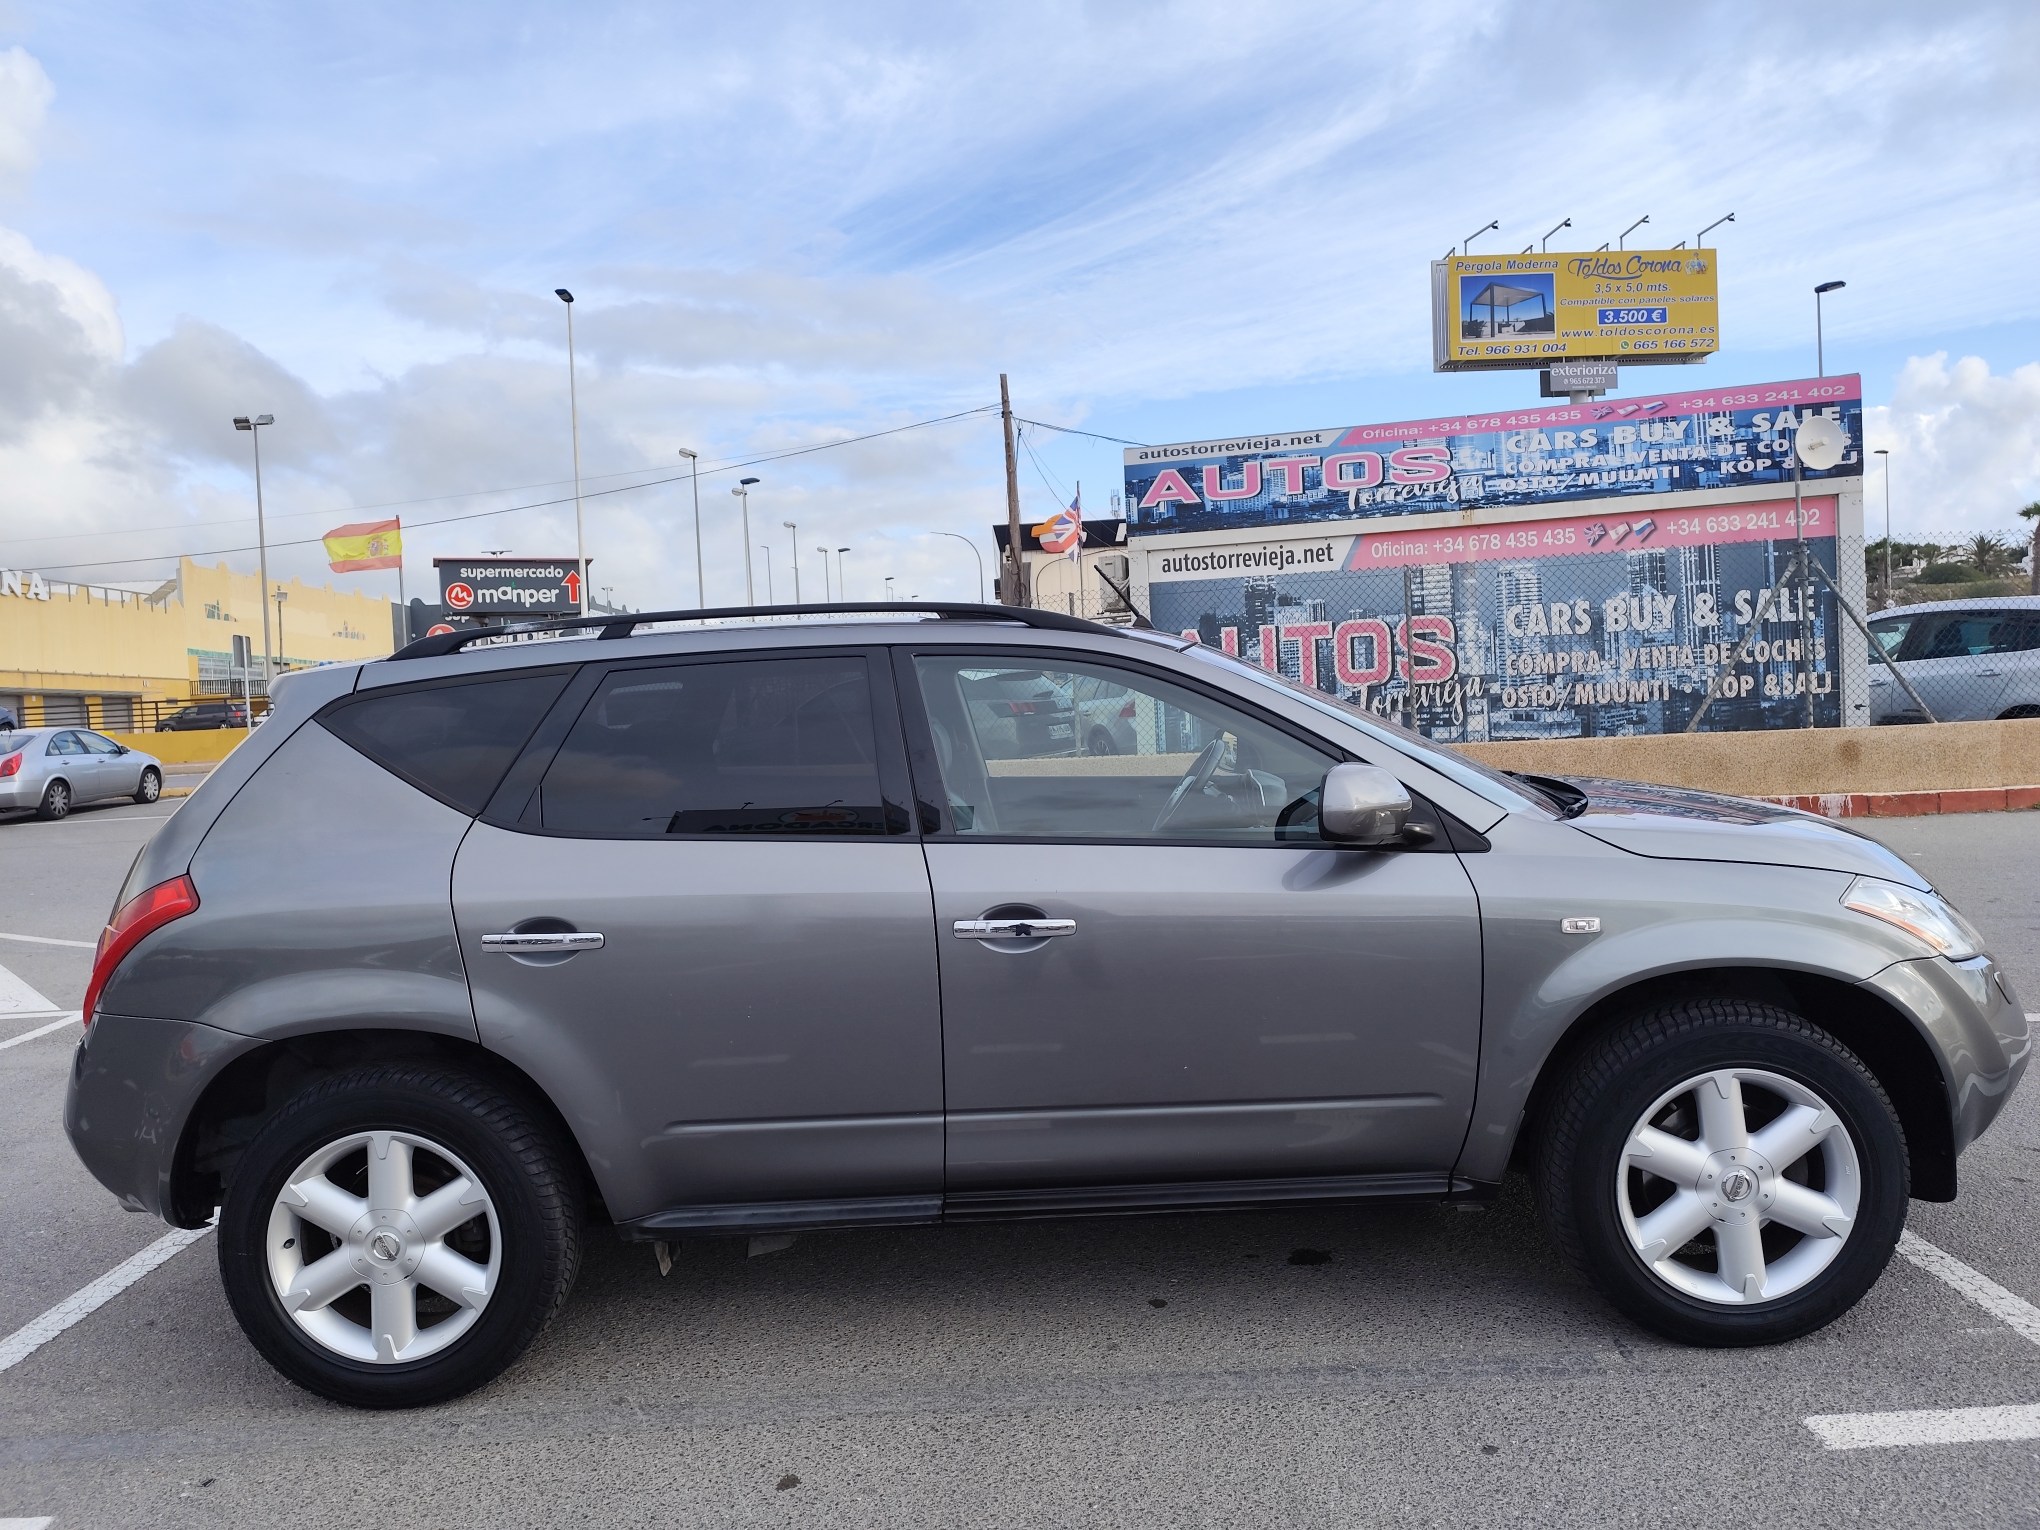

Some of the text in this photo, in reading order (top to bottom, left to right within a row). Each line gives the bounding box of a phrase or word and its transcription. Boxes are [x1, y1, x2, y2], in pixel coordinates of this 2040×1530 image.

[1506, 258, 1559, 270] Moderna
[1567, 255, 1682, 279] Toldos Corona
[1594, 282, 1612, 293] 3,5
[1625, 282, 1643, 293] 5,0
[1646, 282, 1671, 292] mts.
[1559, 294, 1714, 307] Compatible con paneles solares
[1604, 309, 1662, 323] 3.500 €
[1561, 325, 1715, 338] www.toldoscorona.es
[1457, 342, 1567, 356] Tel. 966 931 004
[1633, 338, 1715, 350] 665 166 572
[1551, 364, 1617, 376] exterioriza
[1569, 377, 1581, 385] 965
[1679, 385, 1846, 410] +34 633 241 402
[1138, 410, 1581, 461] autostorrevieja.net Oficina: +34 678 435 435
[1506, 428, 1598, 453] CARS
[1613, 420, 1691, 445] BUY
[1707, 416, 1735, 437] &
[1505, 453, 1608, 475] COMPRA
[1718, 441, 1748, 457] DE
[1720, 457, 1773, 475] KÖP
[1138, 446, 1453, 508] AUTOS
[1342, 475, 1485, 511] Torrevieja
[1666, 508, 1820, 536] +34 633 241 402
[1161, 527, 1576, 574] autostorrevieja.net Oficina: +34 678 435 435
[460, 565, 564, 580] supermercado
[477, 586, 560, 607] manper
[1506, 600, 1592, 638] CARS
[1604, 594, 1678, 633] BUY
[1692, 592, 1721, 628] &
[1181, 614, 1458, 690] TOS
[1703, 642, 1732, 665] DE
